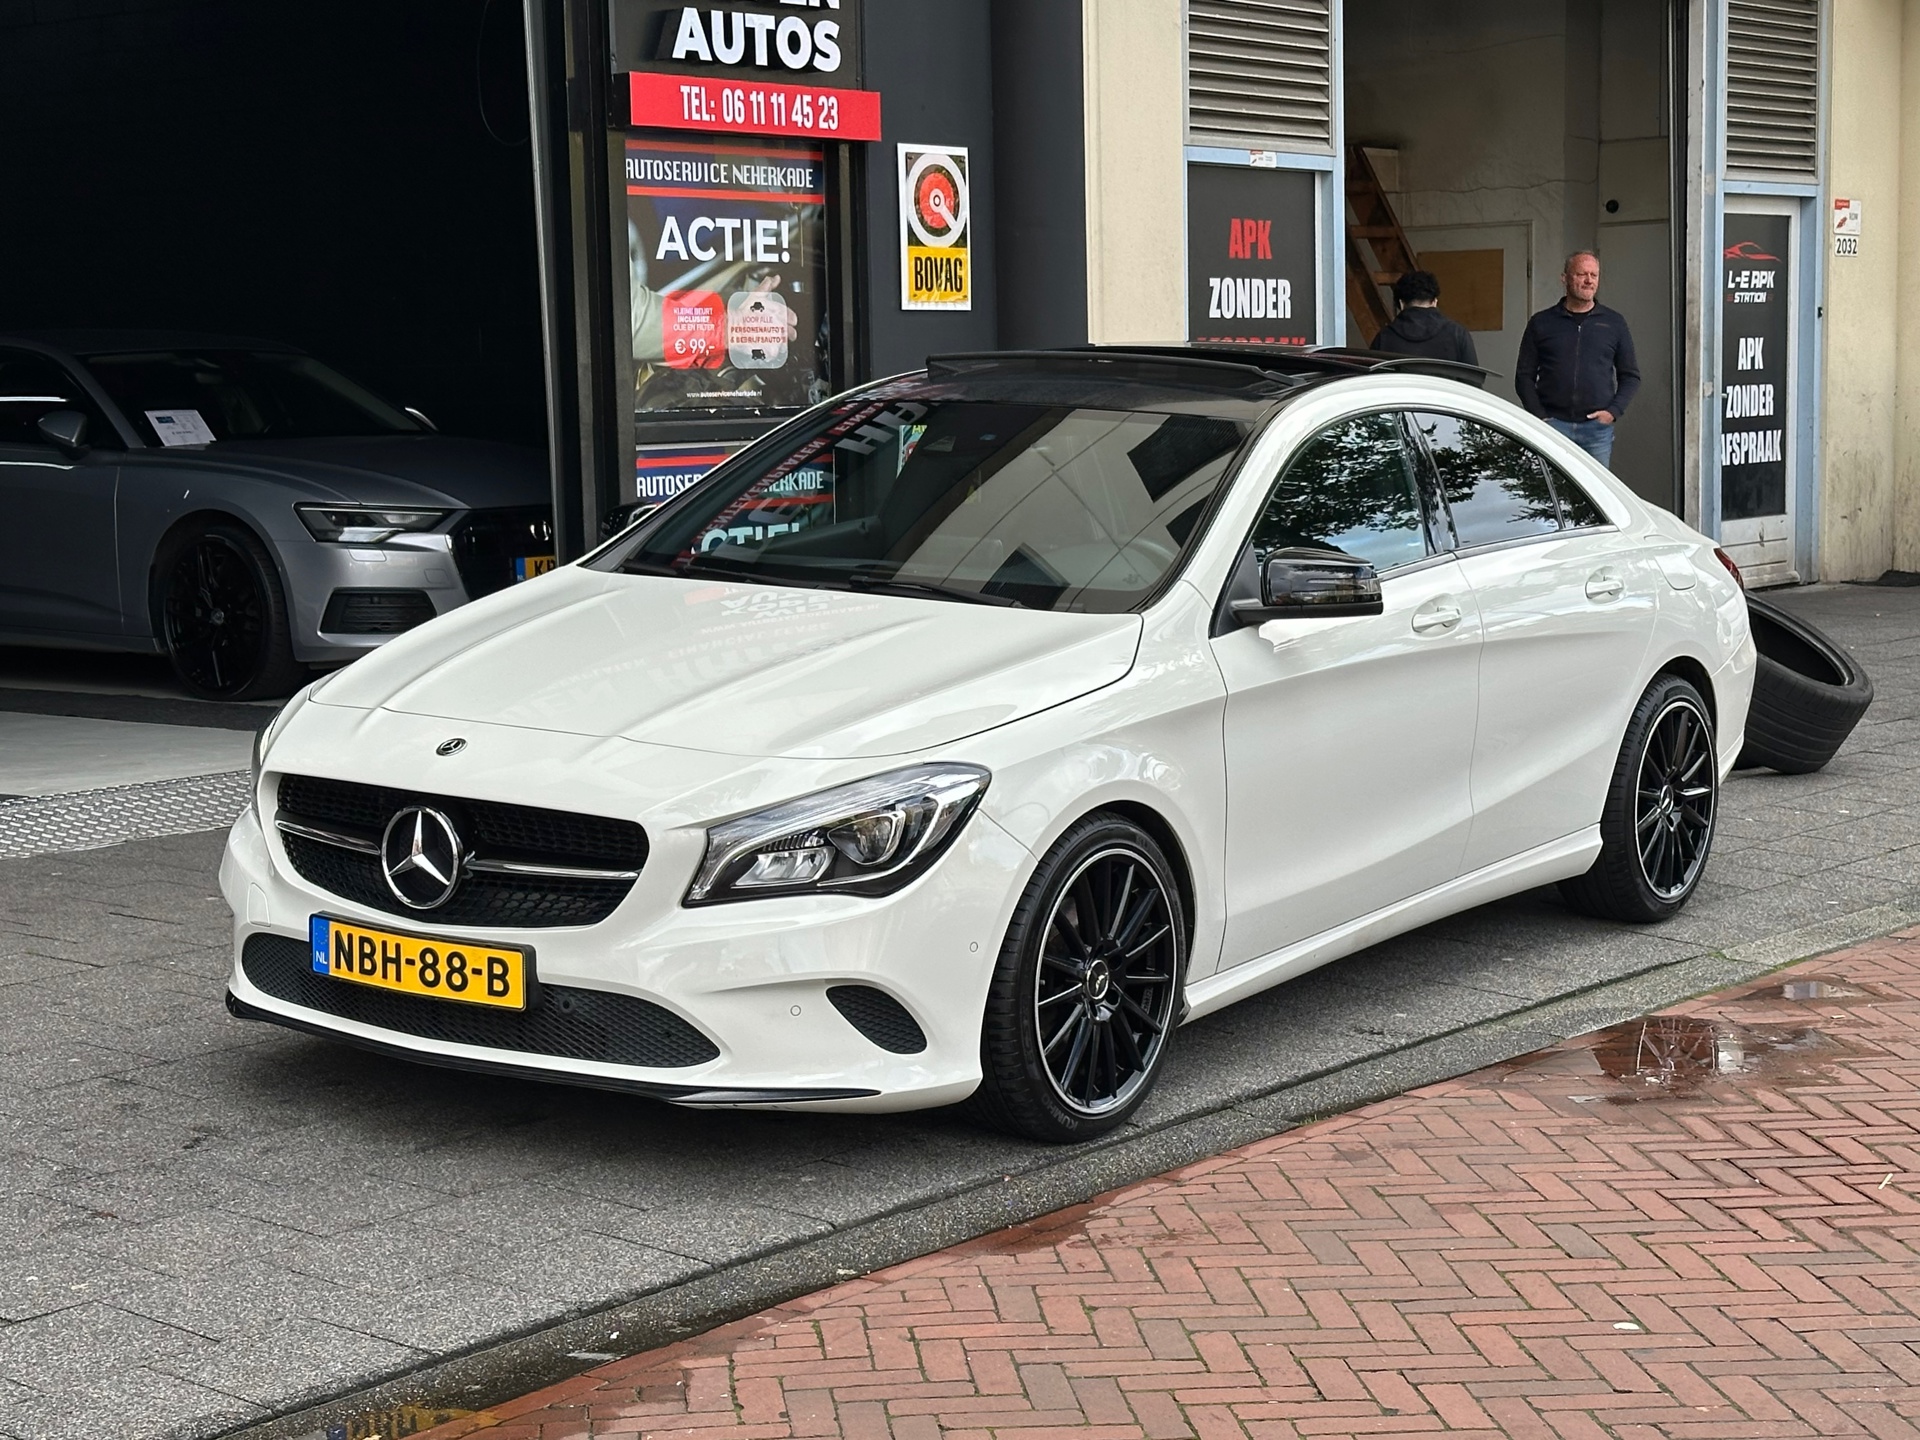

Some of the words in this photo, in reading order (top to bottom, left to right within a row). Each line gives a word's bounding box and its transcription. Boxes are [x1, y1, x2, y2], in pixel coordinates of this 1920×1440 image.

[671, 6, 842, 72] AUTOS
[680, 85, 716, 122] TEL:
[722, 88, 745, 124] 06
[750, 91, 766, 125] 11
[770, 93, 786, 126] 11
[791, 95, 814, 129] 45
[818, 96, 839, 130] 23
[625, 158, 729, 184] AUTOSERVICE
[732, 164, 814, 188] NEHERKADE
[655, 215, 791, 264] ACTIE!
[1228, 218, 1272, 259] APK
[1836, 237, 1857, 254] 2032
[914, 256, 963, 293] BOVAG
[1727, 270, 1751, 289] L-E
[1208, 277, 1292, 319] ZONDER
[1733, 291, 1767, 303] STATION
[677, 315, 710, 323] INCLUSIEF
[674, 338, 686, 354] €
[690, 338, 715, 356] 99,-
[1737, 337, 1764, 370] APK
[1725, 384, 1774, 418] ZONDER
[315, 950, 328, 965] NL
[334, 929, 510, 998] NBH-88-B
[1041, 1092, 1079, 1131] KUMHO
